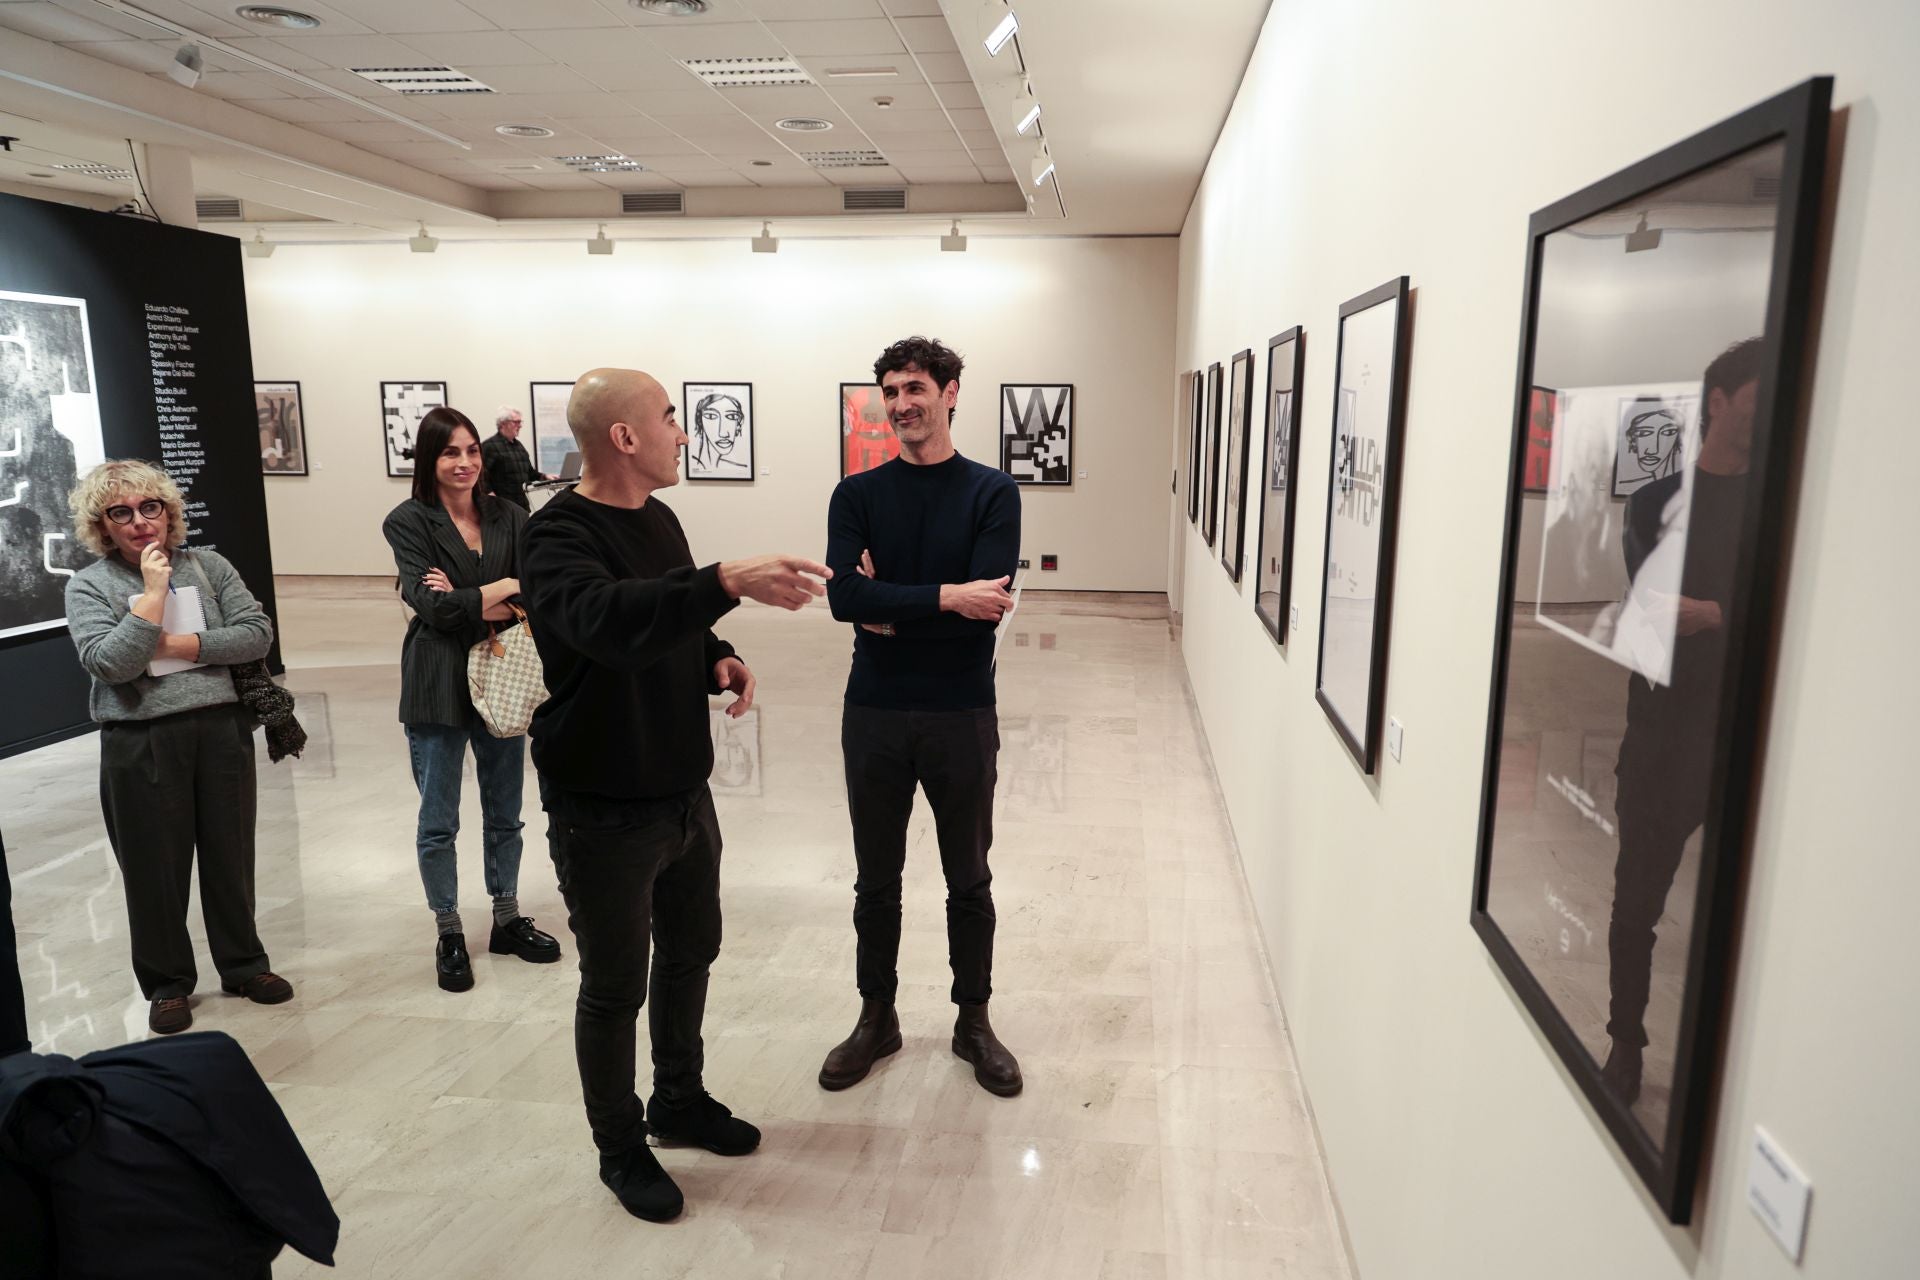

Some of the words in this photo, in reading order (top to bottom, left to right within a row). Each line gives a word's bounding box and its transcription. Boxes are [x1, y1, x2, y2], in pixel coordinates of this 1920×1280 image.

[145, 304, 168, 313] Eduardo
[146, 313, 163, 321] Astrid
[147, 323, 183, 331] Experimental
[149, 332, 171, 341] Anthony
[149, 341, 169, 350] Design
[170, 343, 176, 351] by
[150, 350, 164, 358] Spin
[178, 450, 204, 458] Montague
